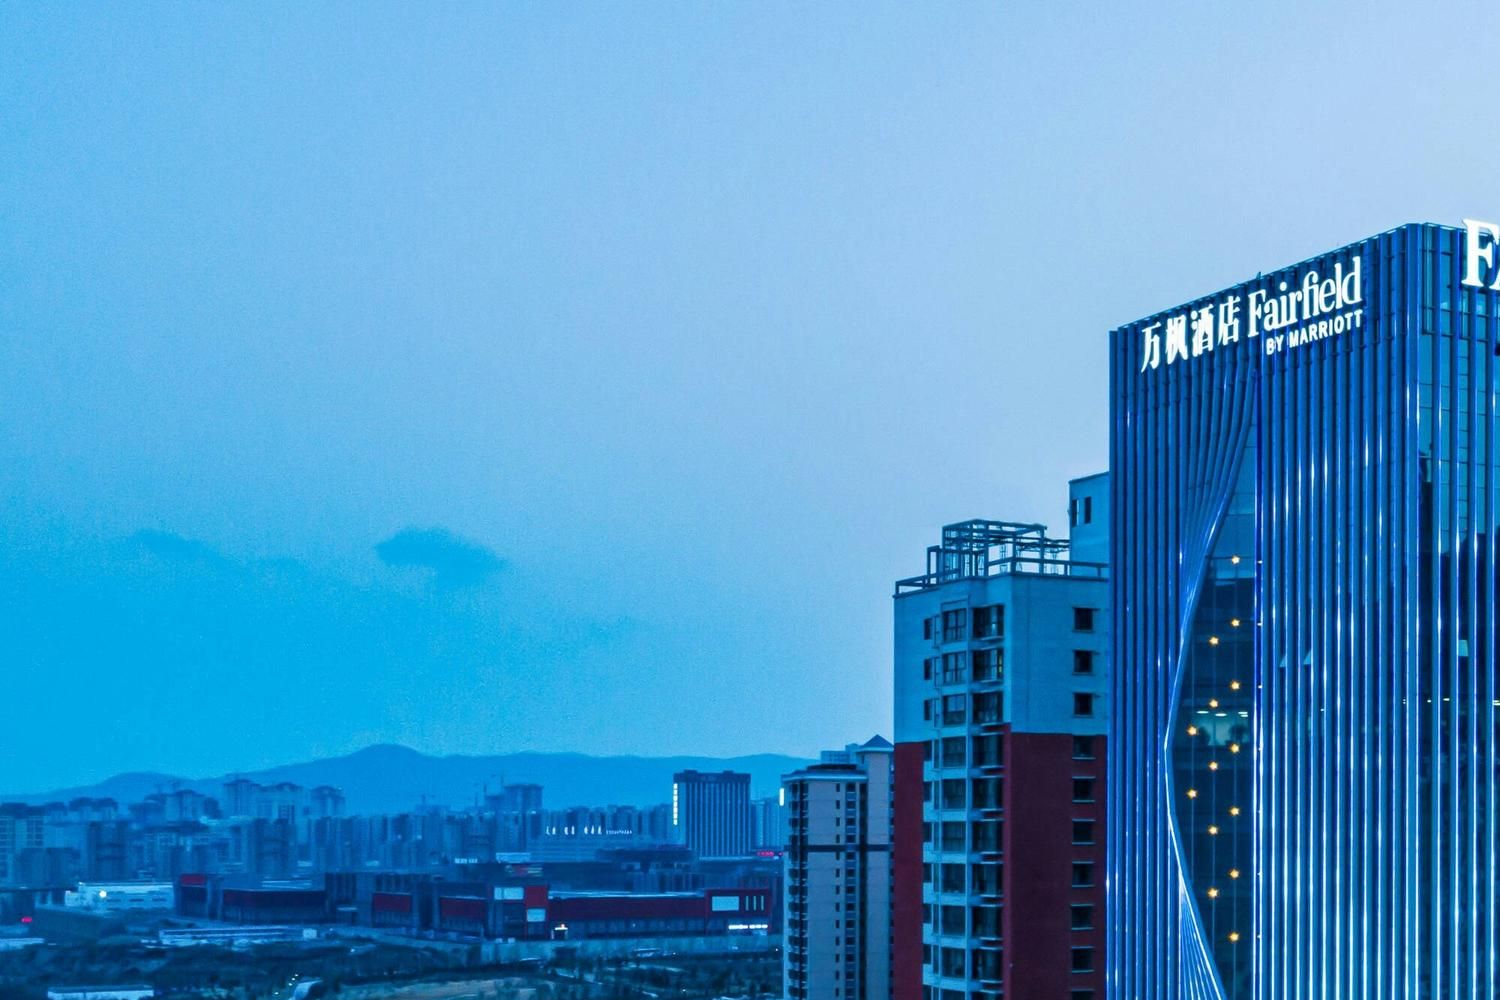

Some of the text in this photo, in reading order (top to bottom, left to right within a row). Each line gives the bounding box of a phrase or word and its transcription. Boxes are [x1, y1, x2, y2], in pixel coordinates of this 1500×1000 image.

[1141, 295, 1241, 373] 万枫酒店
[1247, 255, 1363, 338] Fairfield
[1266, 309, 1364, 355] BY MARRIOTT
